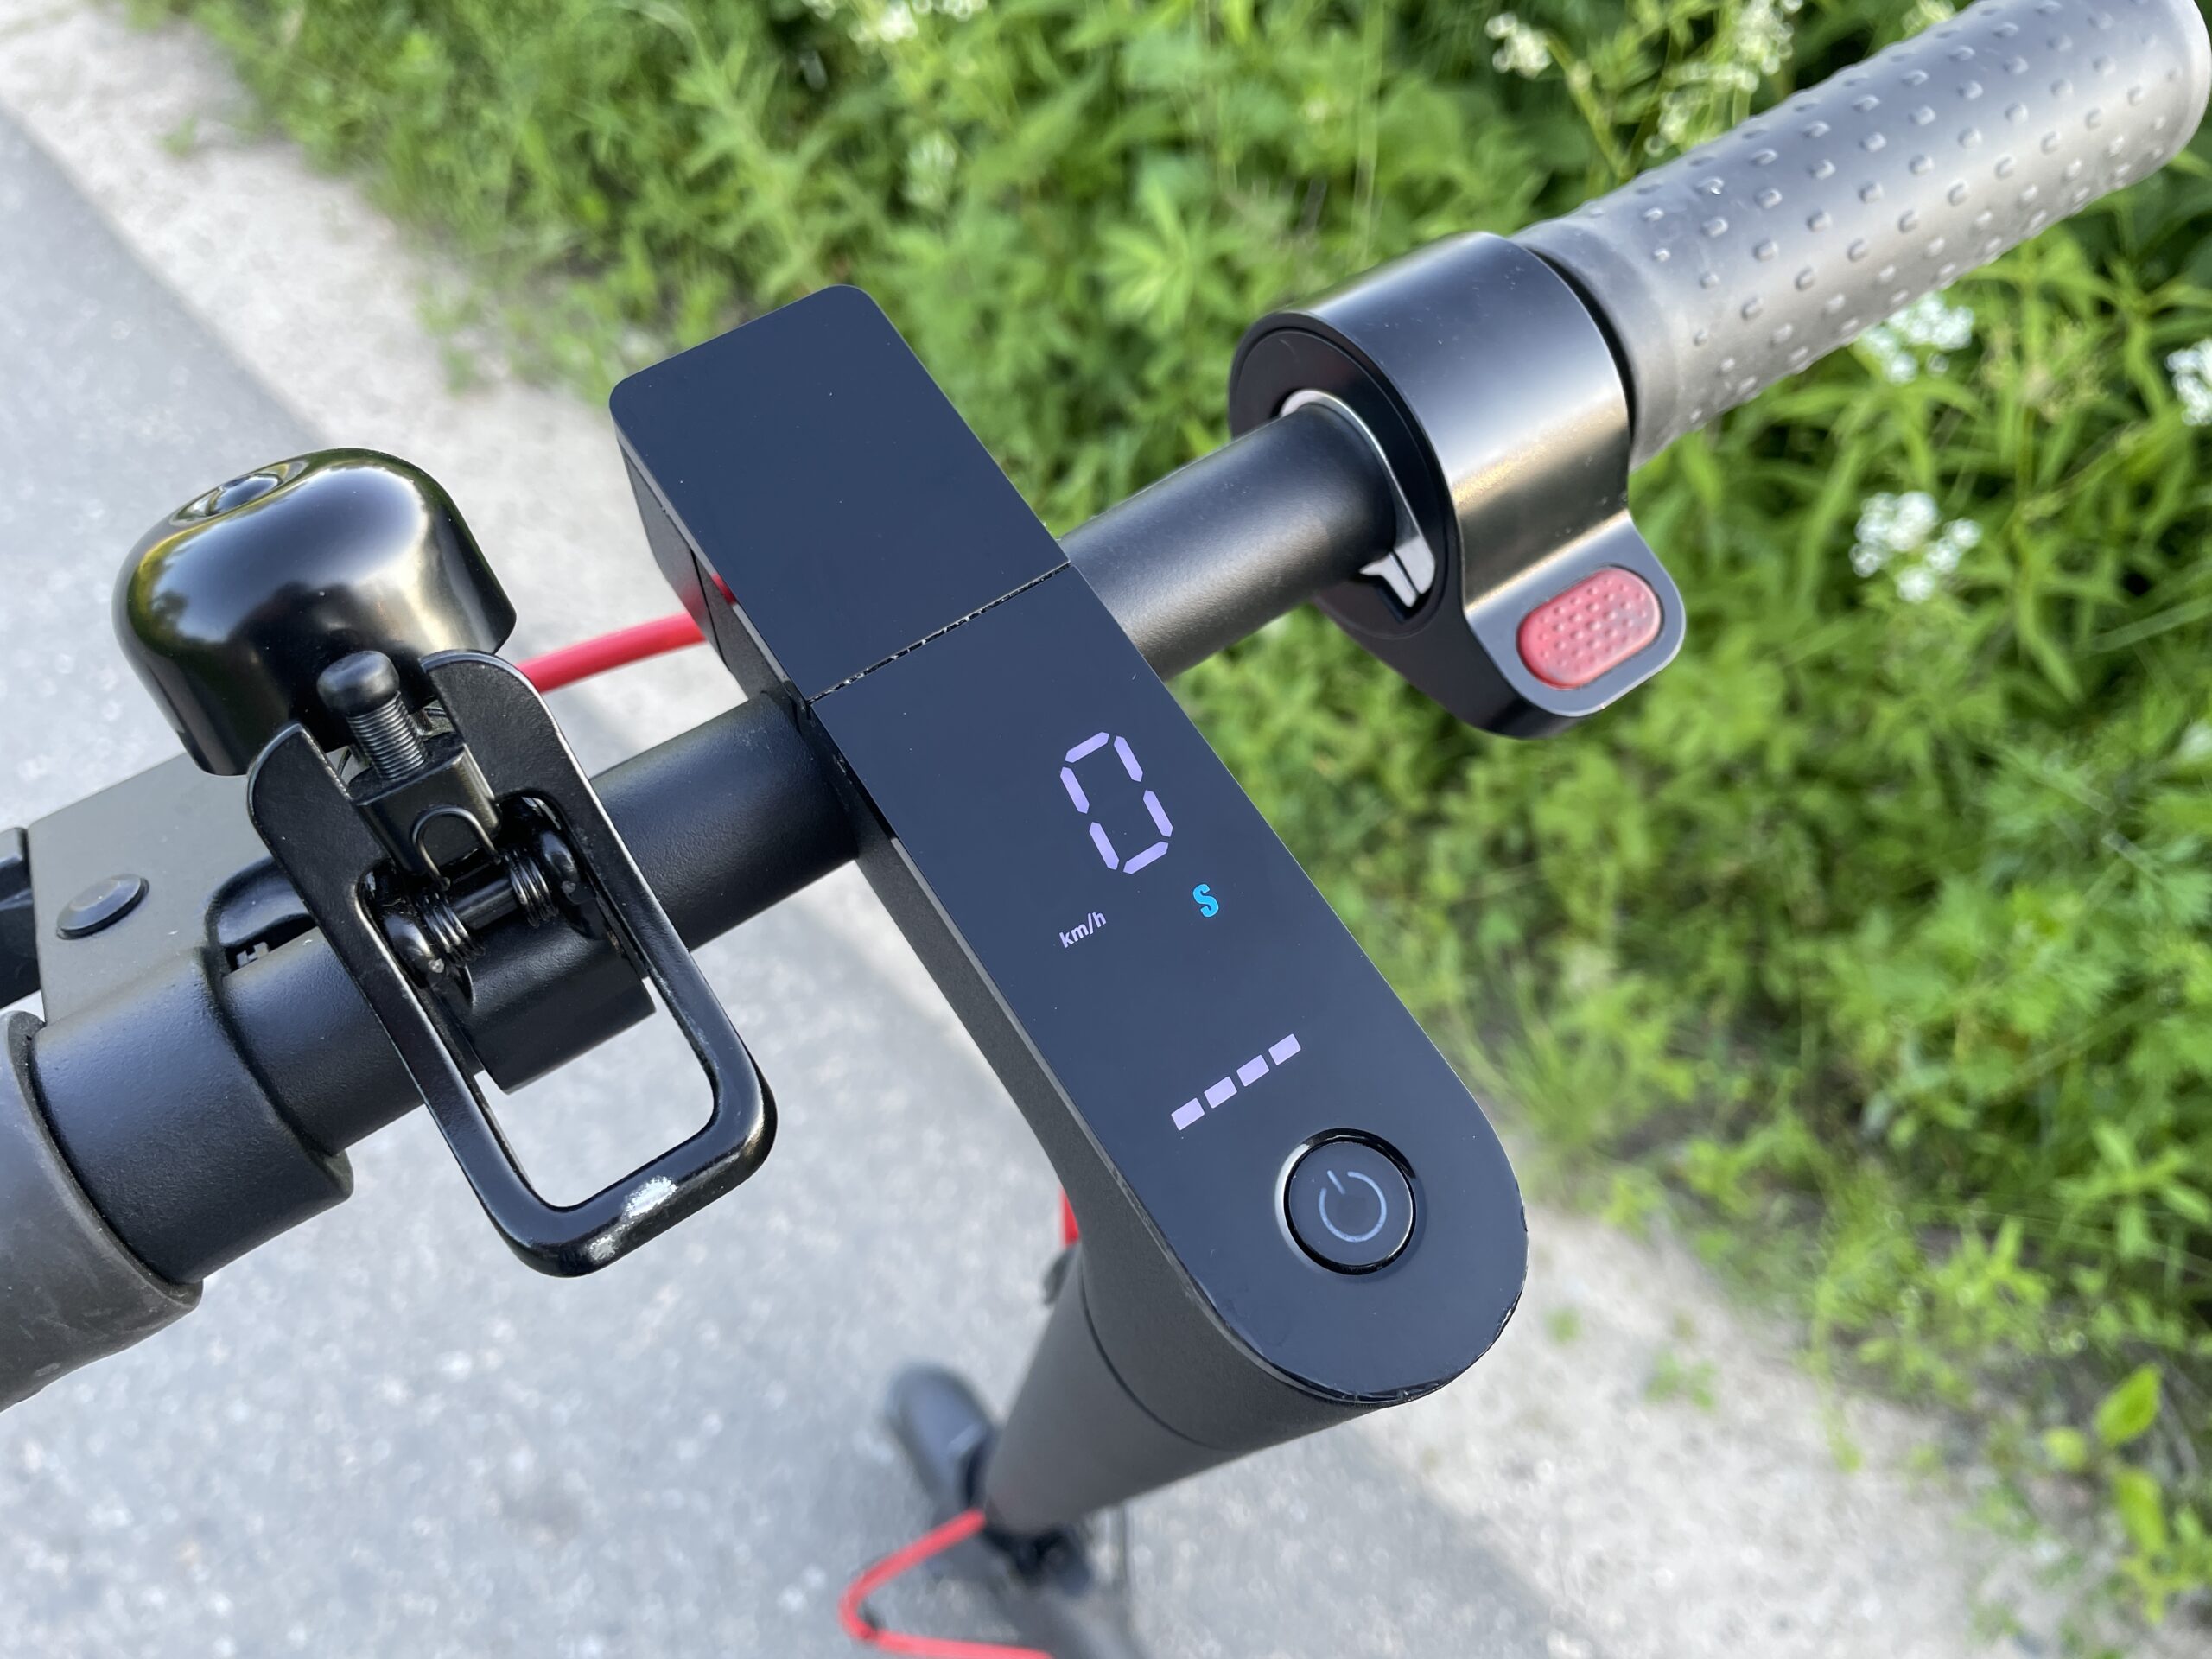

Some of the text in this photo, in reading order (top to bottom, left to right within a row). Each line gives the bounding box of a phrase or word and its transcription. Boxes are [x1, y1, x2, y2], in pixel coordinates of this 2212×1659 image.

[1059, 731, 1174, 875] 0
[1192, 883, 1219, 918] S
[1058, 912, 1107, 948] km/h
